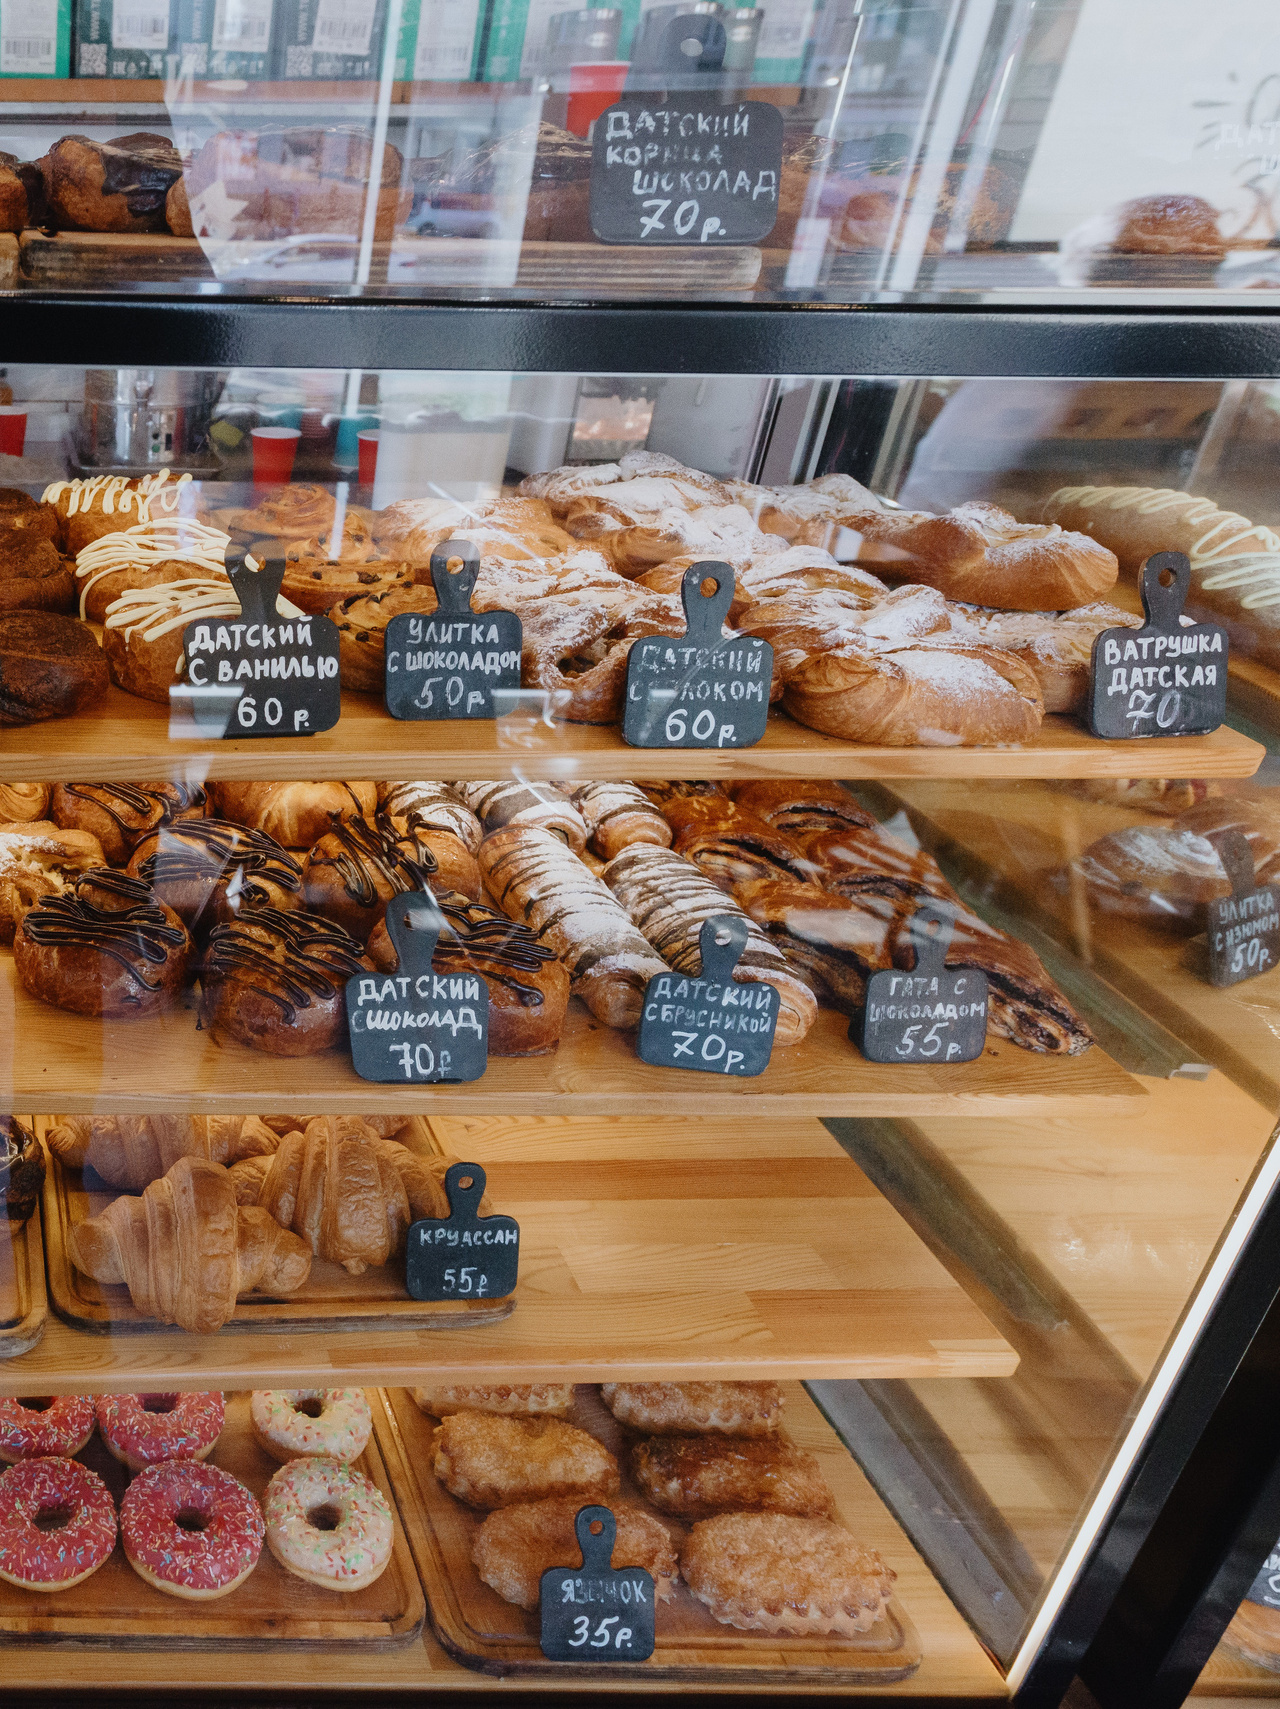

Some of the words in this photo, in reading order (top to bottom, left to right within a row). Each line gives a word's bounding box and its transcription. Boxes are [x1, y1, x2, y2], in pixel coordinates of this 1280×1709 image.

[633, 169, 776, 201] ШОКОЛАД
[188, 616, 313, 657] ДАТСКИЙ
[406, 618, 499, 644] УЛИТКА
[406, 651, 521, 675] ШОКОЛАДОМ
[1104, 633, 1222, 665] ВАТРУШКА
[189, 658, 208, 686] С
[218, 655, 339, 682] ВАНИЛЬЮ
[1107, 665, 1217, 696] ДАТСКАЯ
[1219, 892, 1274, 924] УЛИТКА
[1226, 912, 1279, 947] ИЗЮМОМ
[357, 975, 479, 1006] ДАТСКИЙ
[654, 977, 771, 1010] ДАТСКИЙ
[890, 977, 939, 998] ГАТА
[420, 1228, 518, 1247] КРУАССАН
